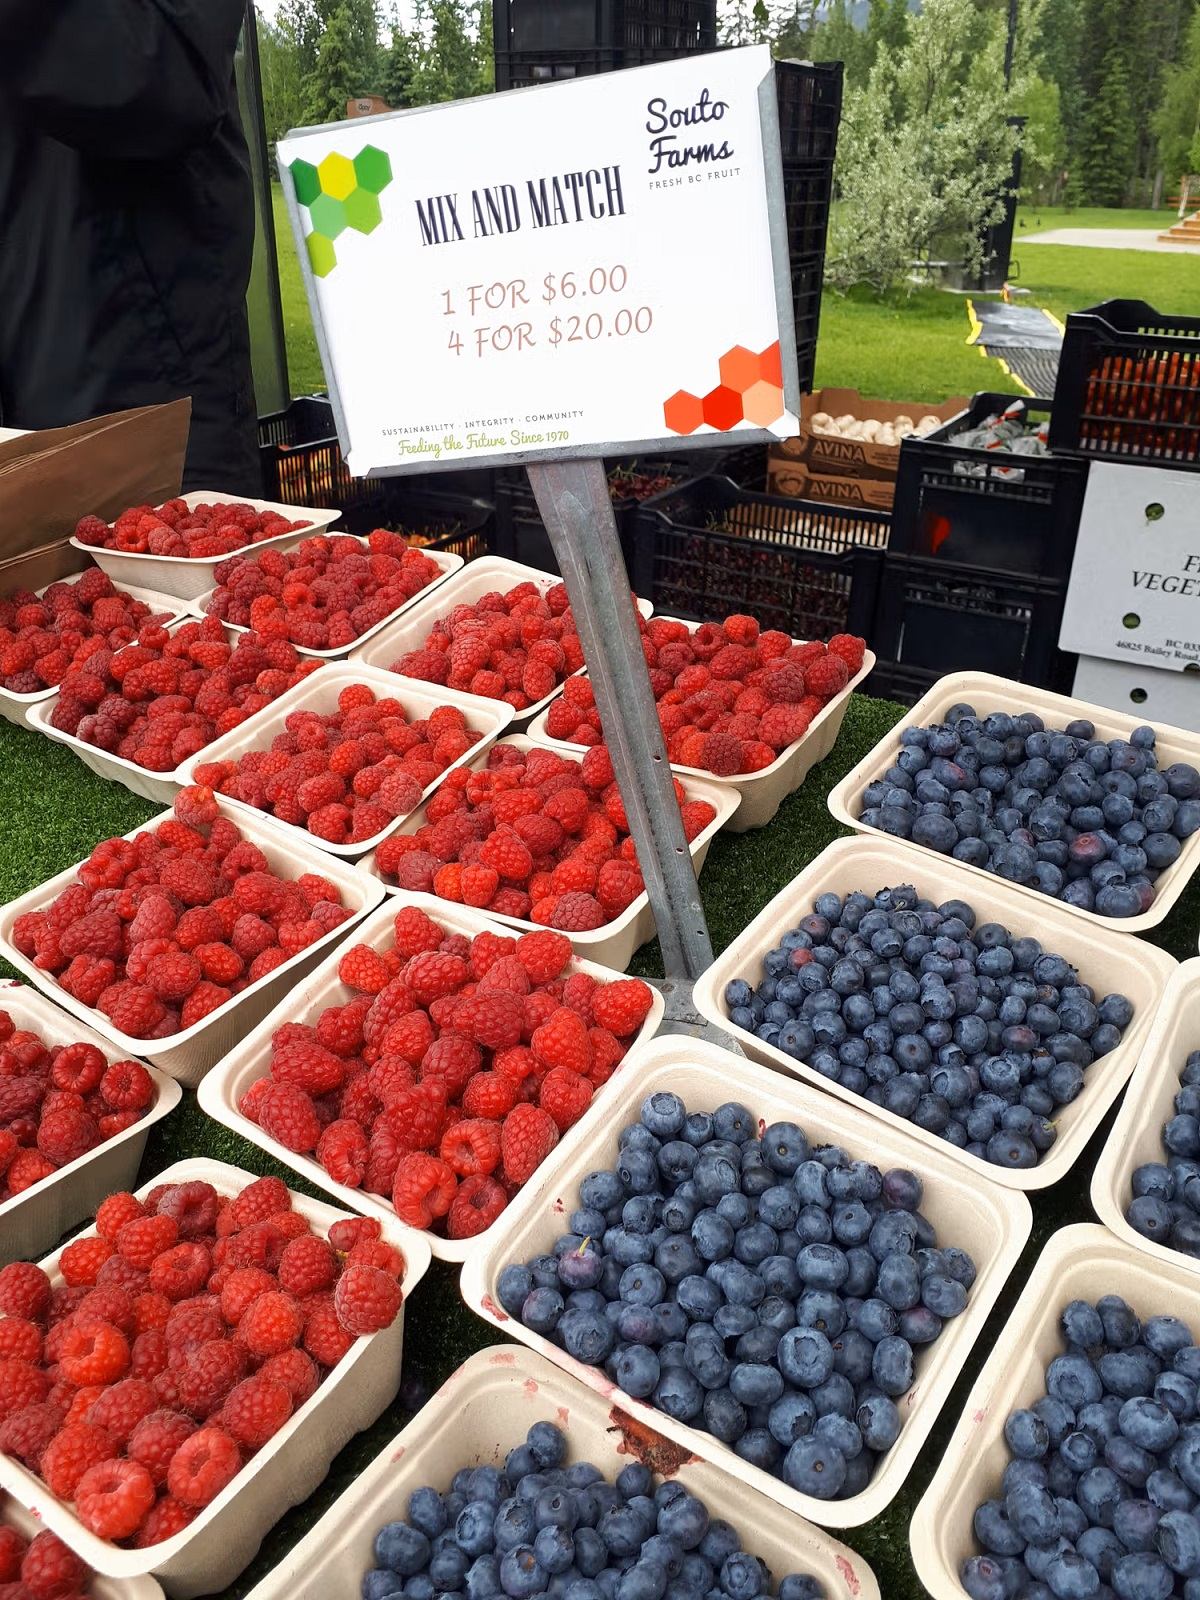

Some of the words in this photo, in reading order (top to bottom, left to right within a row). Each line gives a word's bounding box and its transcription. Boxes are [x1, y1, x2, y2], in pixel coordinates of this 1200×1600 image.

[646, 88, 729, 134] Souto
[648, 135, 734, 174] Farms
[649, 177, 682, 190] FRESH
[688, 174, 702, 184] BC
[708, 167, 741, 180] FRUIT
[414, 193, 466, 247] MIX
[471, 184, 521, 238] AND
[526, 165, 626, 229] MATCH
[440, 289, 456, 316] 1
[467, 279, 530, 316] FOR
[542, 264, 627, 305] $6.00
[448, 330, 464, 356] 4
[474, 322, 536, 358] FOR
[548, 306, 653, 348] $20.00
[381, 423, 455, 436] SUSTAINABILITY
[464, 417, 514, 429] INTEGRITY
[525, 410, 584, 423] COMMUNITY
[398, 437, 442, 459] Feeding
[443, 434, 463, 451] the
[466, 432, 506, 450] Future
[510, 429, 544, 446] Since
[546, 430, 569, 442] 1970
[812, 440, 866, 463] AVINA
[810, 480, 864, 500] AVINA
